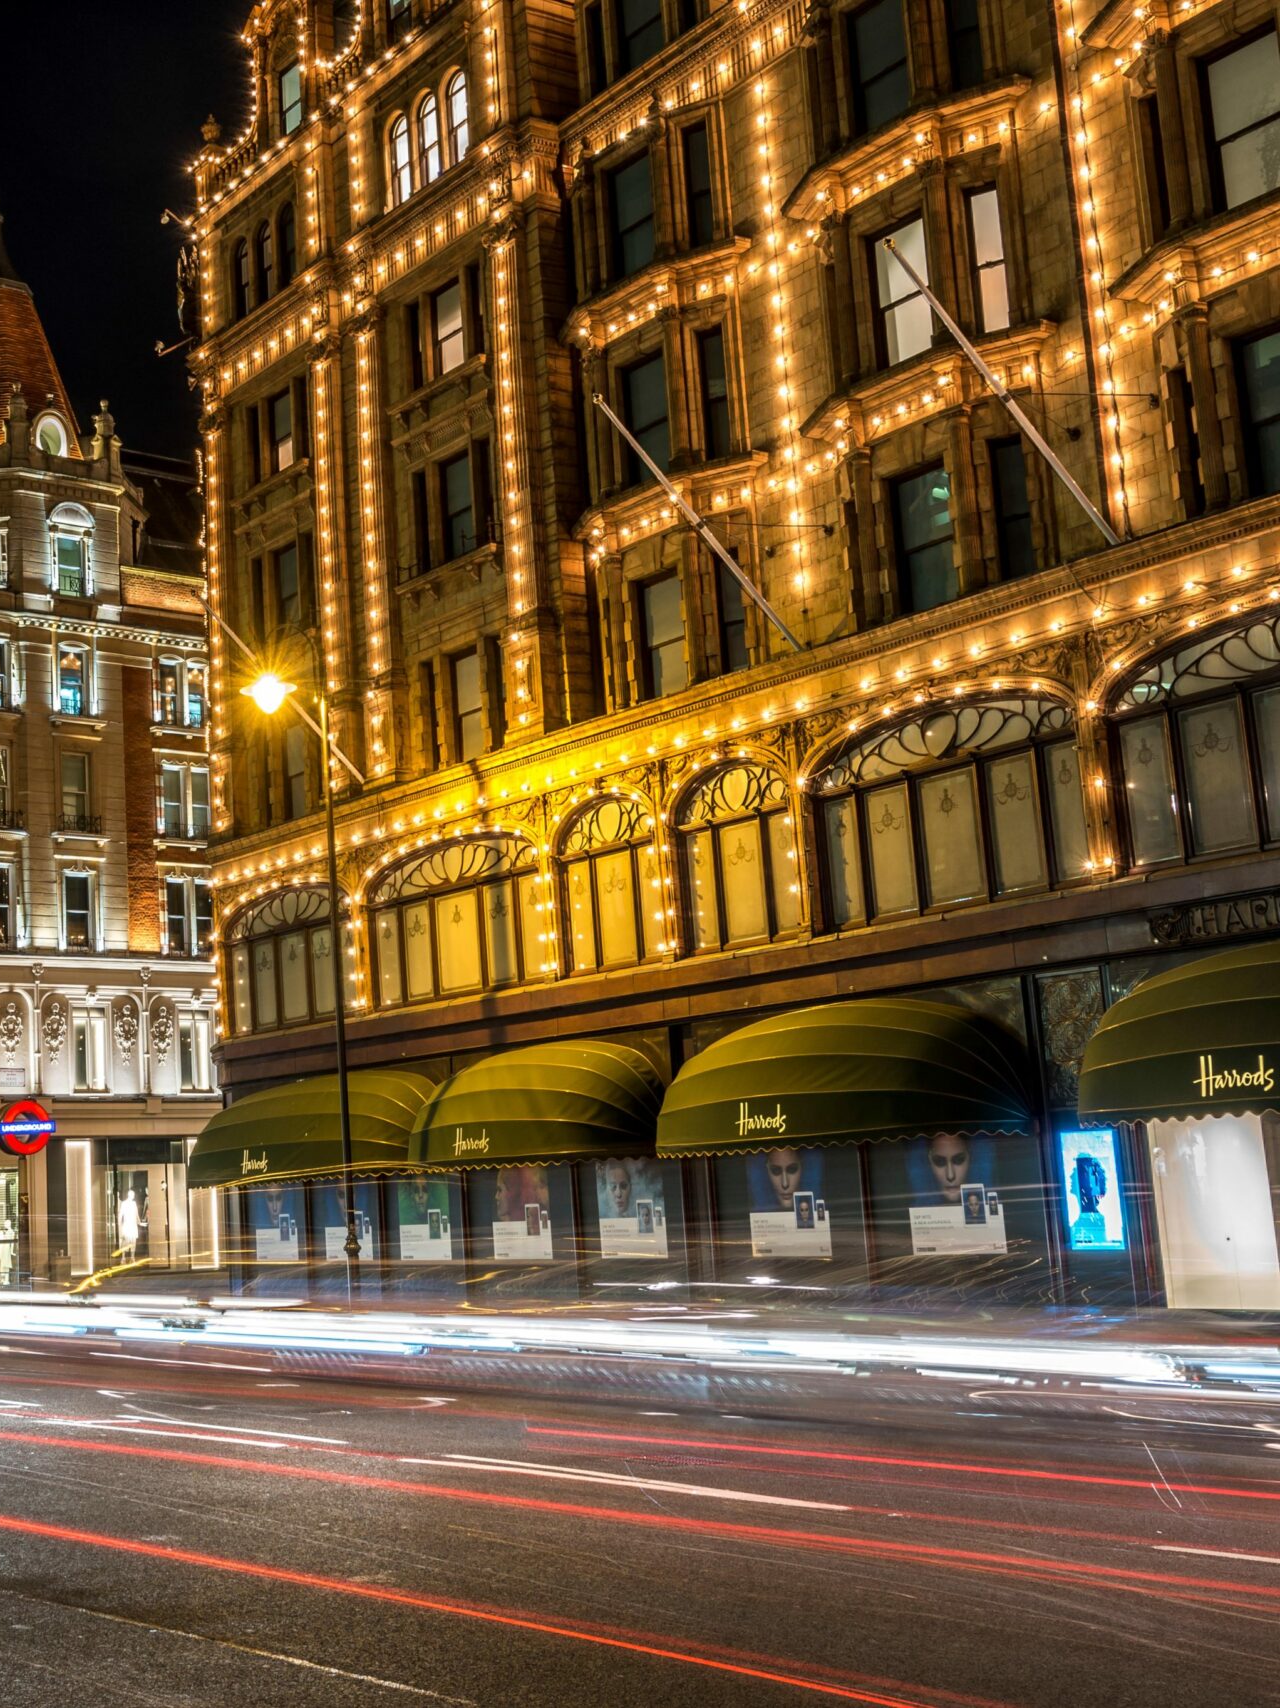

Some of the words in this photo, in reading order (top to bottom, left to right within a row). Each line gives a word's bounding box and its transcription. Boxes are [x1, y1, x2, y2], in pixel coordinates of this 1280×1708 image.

[1192, 1054, 1275, 1097] Harrods
[1, 1123, 52, 1132] UNDERGROUND
[735, 1102, 787, 1136] Harrods
[452, 1127, 490, 1156] Harrods
[240, 1149, 268, 1175] Harrods
